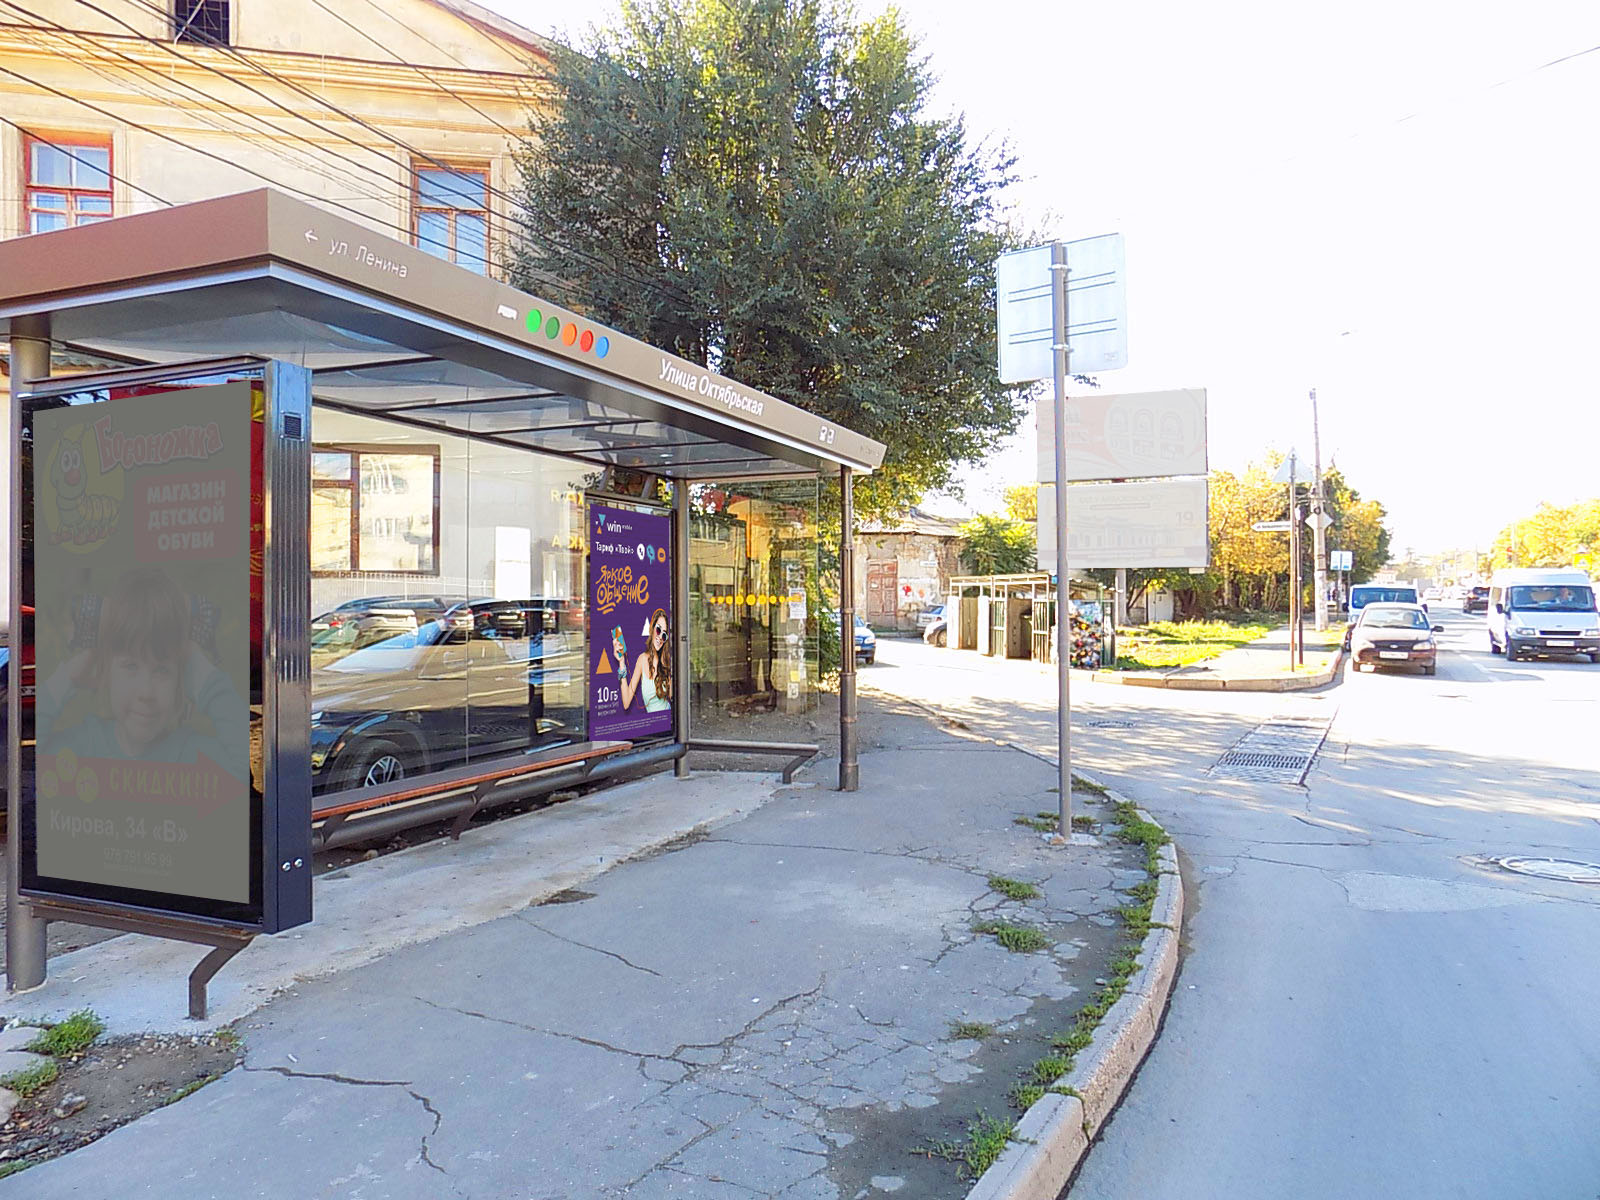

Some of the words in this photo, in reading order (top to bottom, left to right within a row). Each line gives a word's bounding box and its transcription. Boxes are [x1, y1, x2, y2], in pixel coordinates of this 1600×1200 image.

[355, 245, 408, 278] Ленина
[659, 358, 698, 392] Улица
[698, 374, 764, 416] Октябрьская
[94, 415, 222, 473] Босоножка
[146, 480, 226, 504] МАГАЗИН
[147, 501, 225, 531] ДЕТСКОЙ
[607, 520, 622, 533] win
[157, 531, 215, 551] ОБУВИ
[596, 542, 614, 554] Тариф
[597, 686, 609, 703] 10
[109, 767, 220, 800] СКИДКИ!!!
[50, 808, 120, 840] Кирова,
[125, 816, 146, 840] 34
[152, 819, 189, 843] «В»
